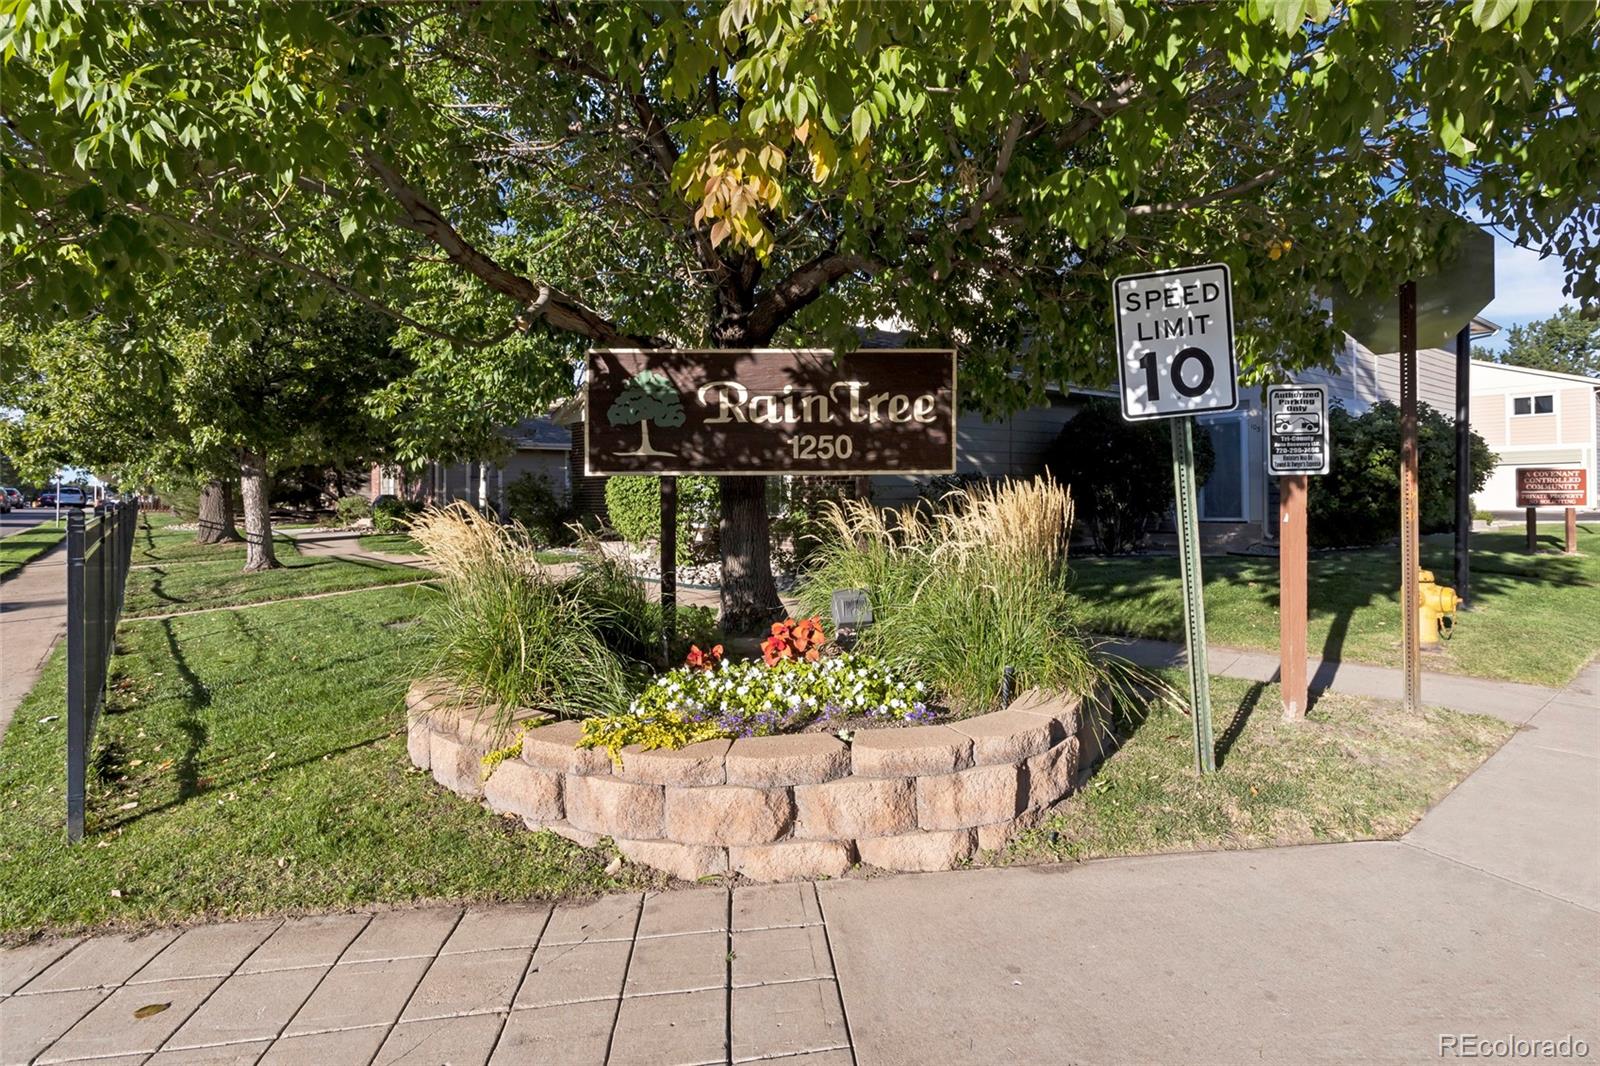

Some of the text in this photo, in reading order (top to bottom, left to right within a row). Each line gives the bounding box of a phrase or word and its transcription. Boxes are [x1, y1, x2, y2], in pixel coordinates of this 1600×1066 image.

[1126, 283, 1219, 312] SPEED
[1138, 314, 1209, 341] LIMIT
[1140, 347, 1214, 401] 10
[790, 434, 852, 460] 1250
